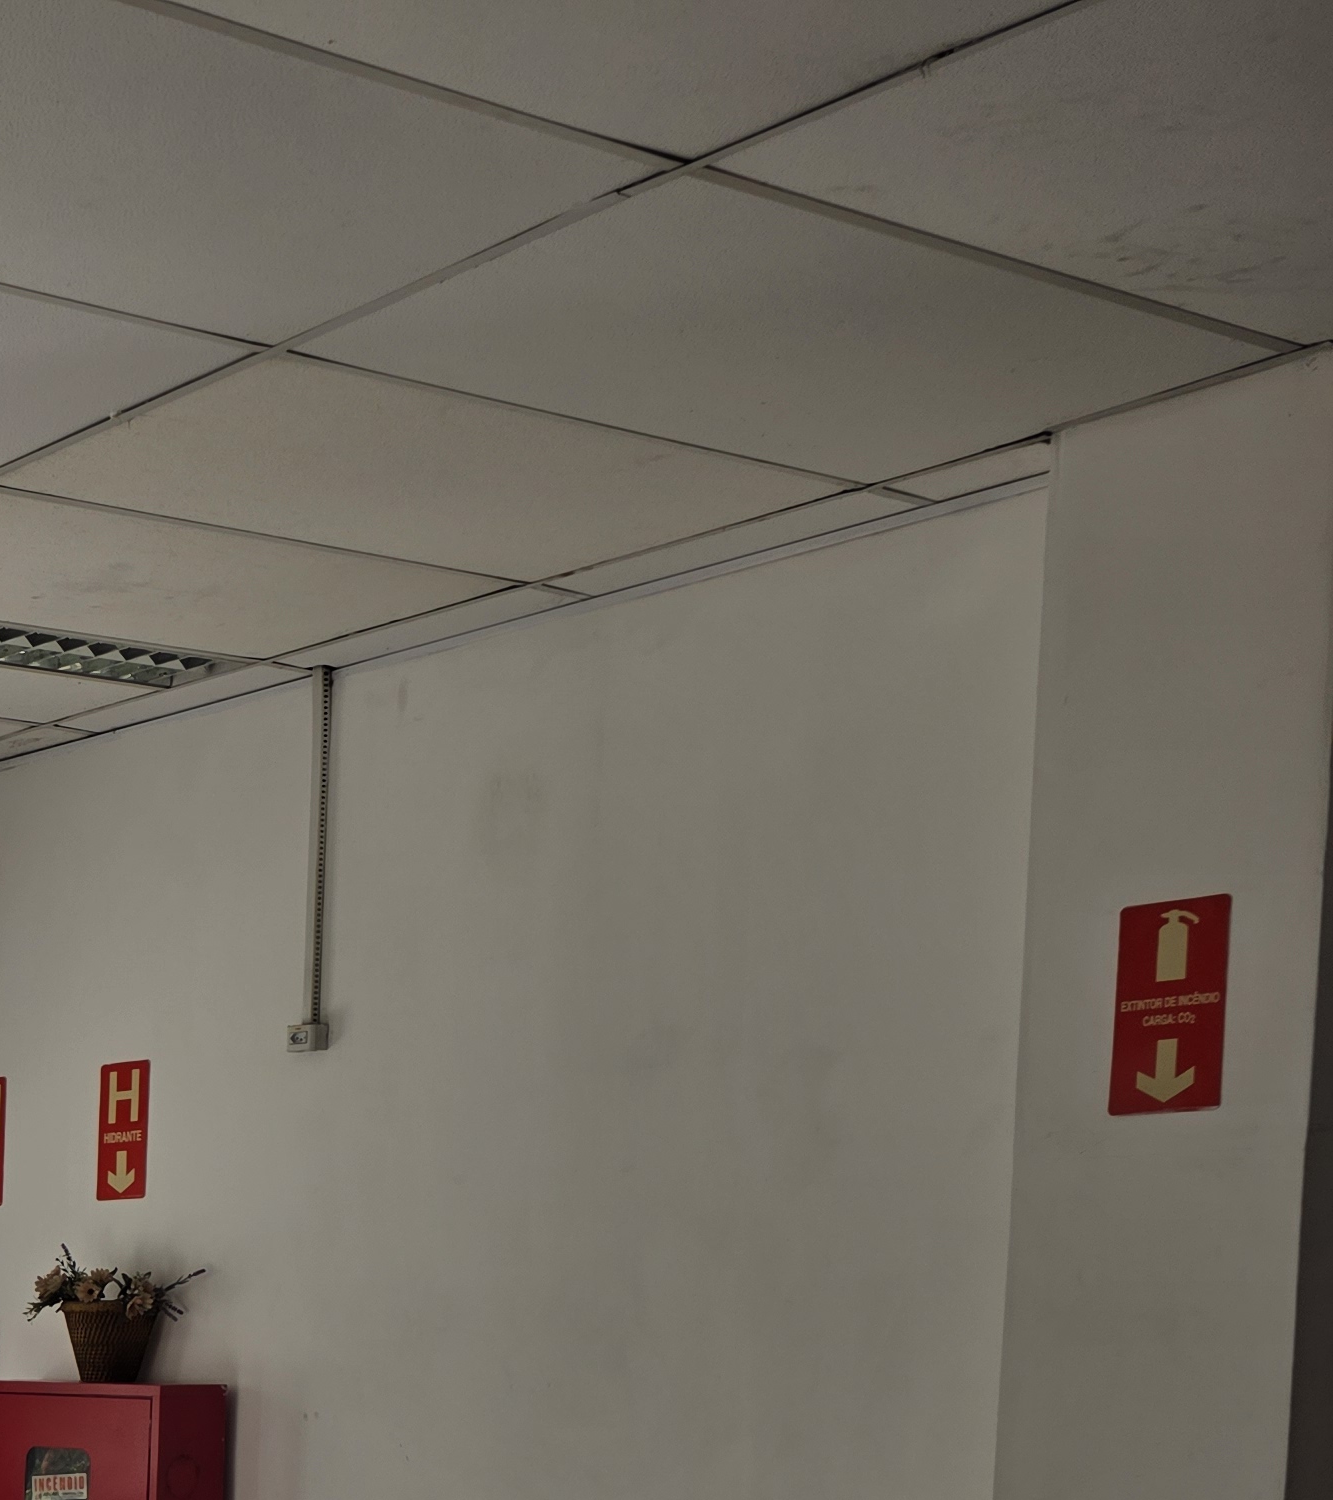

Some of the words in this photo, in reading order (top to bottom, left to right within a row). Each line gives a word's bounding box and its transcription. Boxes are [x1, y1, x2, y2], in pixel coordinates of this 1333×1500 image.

[1121, 998, 1163, 1012] EXTINTOR
[1164, 996, 1177, 1008] DE
[1178, 991, 1220, 1006] INCÊNDIO
[1142, 1013, 1176, 1027] CARGA:
[108, 1068, 140, 1124] H
[103, 1130, 142, 1144] HIDRANTE
